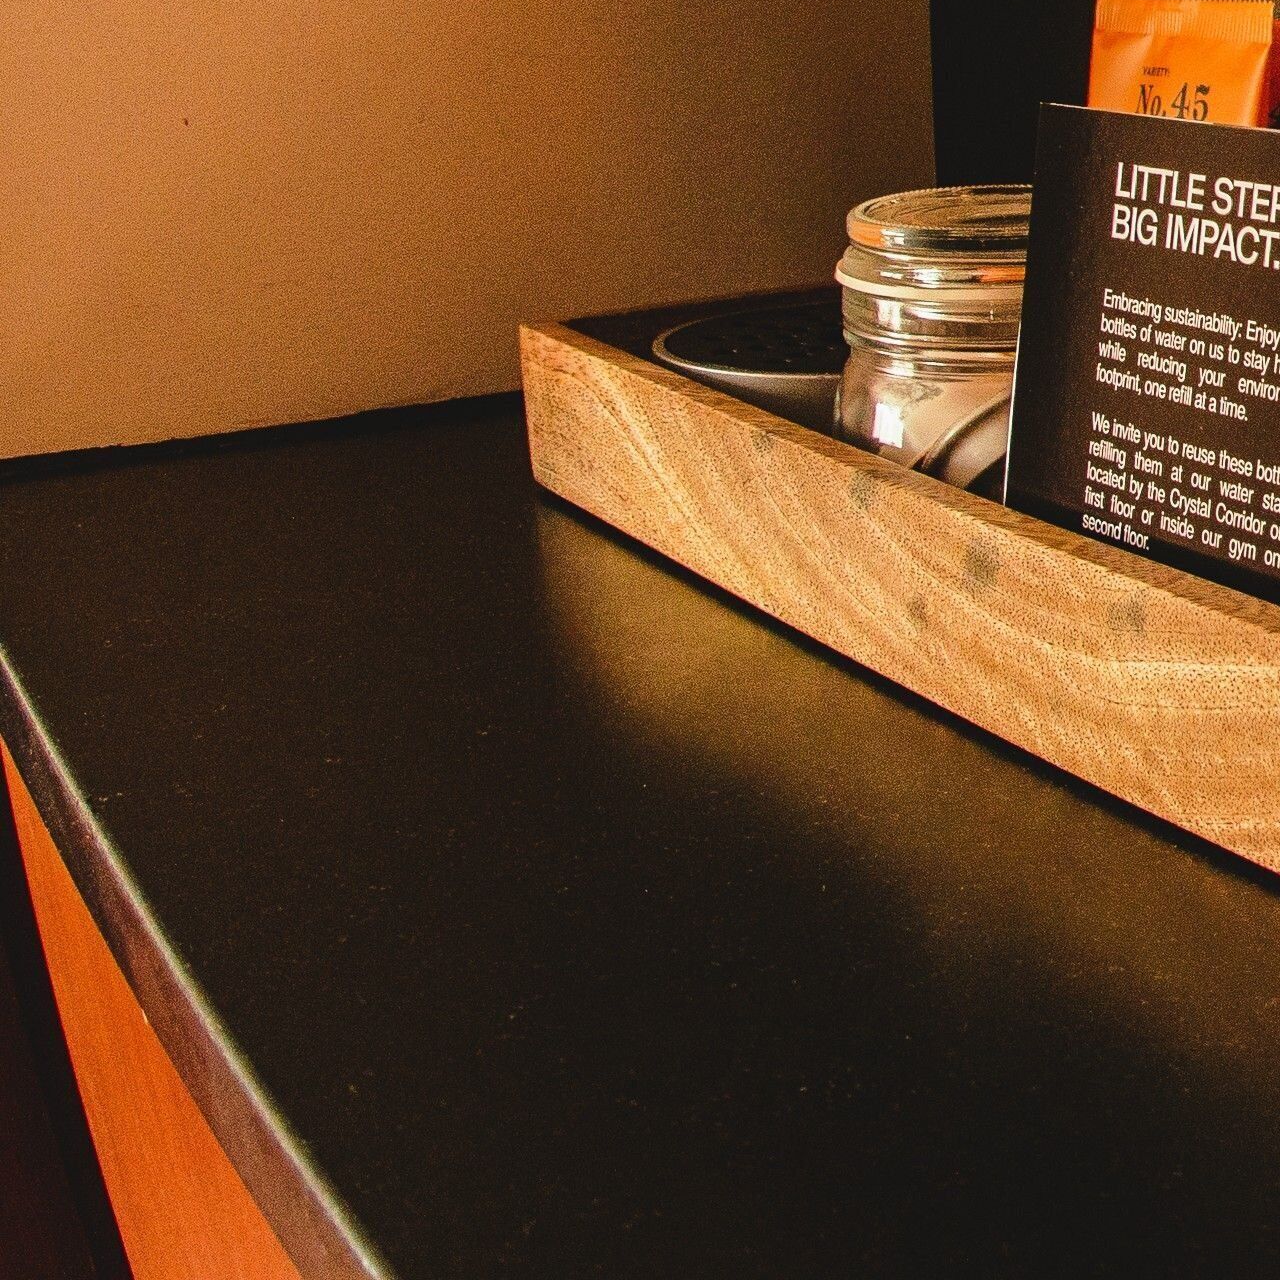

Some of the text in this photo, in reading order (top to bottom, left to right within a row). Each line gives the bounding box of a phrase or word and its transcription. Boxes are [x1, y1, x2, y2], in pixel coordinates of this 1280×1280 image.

[1135, 82, 1211, 122] No. 45
[1114, 162, 1206, 211] LITTLE
[1111, 203, 1280, 270] BIG IMPACT.
[1100, 313, 1137, 340] bottles
[1140, 324, 1153, 343] of
[1154, 330, 1187, 352] water
[1189, 338, 1205, 356] on
[1208, 342, 1224, 361] us
[1227, 344, 1240, 364] to
[1243, 349, 1270, 376] stay
[1103, 288, 1162, 323] Embracing
[1164, 307, 1243, 342] sustainability:
[1246, 320, 1280, 351] Enjoy
[1096, 362, 1249, 422] footprint, one refill at a time.
[1098, 340, 1126, 362] while
[1137, 350, 1187, 382] reducing
[1198, 367, 1226, 388] your
[1088, 439, 1127, 470] refilling
[1134, 451, 1163, 477] them
[1171, 464, 1183, 484] at
[1190, 472, 1212, 491] our
[1219, 478, 1255, 505] water
[1092, 410, 1111, 434] We
[1112, 418, 1141, 443] invite
[1142, 430, 1165, 451] you
[1167, 435, 1180, 455] to
[1181, 441, 1216, 466] reuse
[1219, 449, 1253, 477] these
[1084, 486, 1105, 509] first
[1110, 494, 1135, 520] floor
[1141, 508, 1155, 527] or
[1160, 511, 1195, 540] inside
[1201, 529, 1223, 549] our
[1228, 537, 1257, 561] gym
[1264, 549, 1280, 569] on
[1086, 460, 1126, 491] located
[1129, 474, 1144, 500] by
[1148, 480, 1165, 504] the
[1169, 487, 1211, 519] Crystal
[1215, 502, 1267, 537] Corridor
[1082, 512, 1150, 551] second floor.
